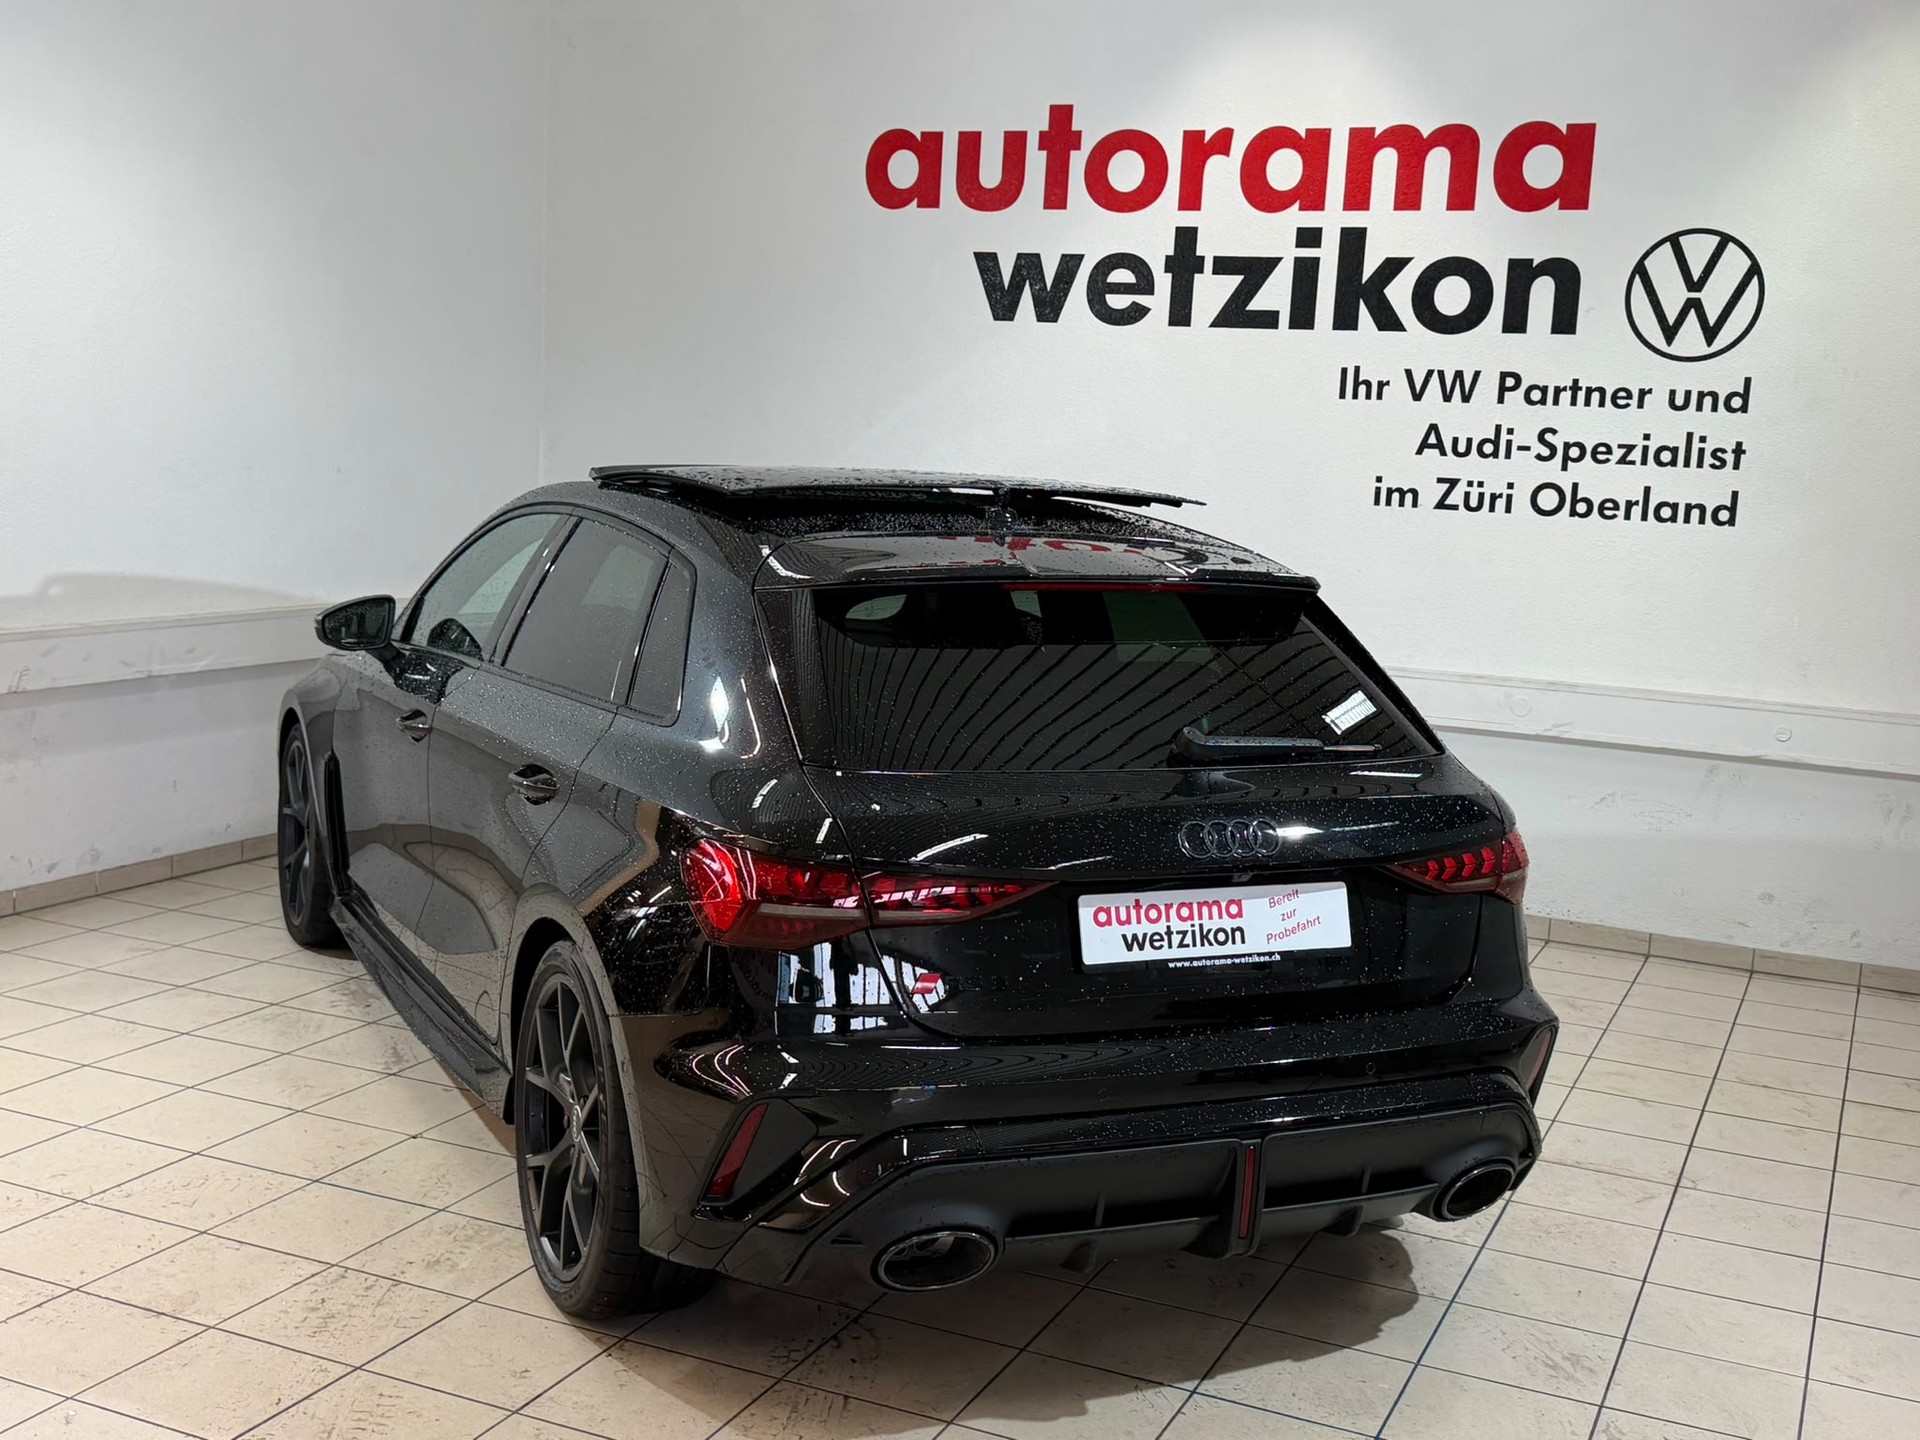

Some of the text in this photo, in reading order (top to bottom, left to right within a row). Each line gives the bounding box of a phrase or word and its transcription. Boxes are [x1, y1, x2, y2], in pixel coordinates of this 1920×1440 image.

[866, 105, 1597, 213] autorama
[973, 227, 1582, 335] wetzikon
[1339, 366, 1752, 413] Ihr VW Partner und
[1415, 423, 1747, 472] Audi-Spezialist
[1373, 477, 1739, 527] im Züri Oberland
[1093, 899, 1244, 928] autorama
[1268, 888, 1300, 909] Bereit
[1280, 907, 1297, 922] zur
[1121, 924, 1246, 952] wetzikon
[1266, 915, 1322, 945] Probefahrt
[1168, 952, 1281, 968] www.autorama-wetzikon.ch
